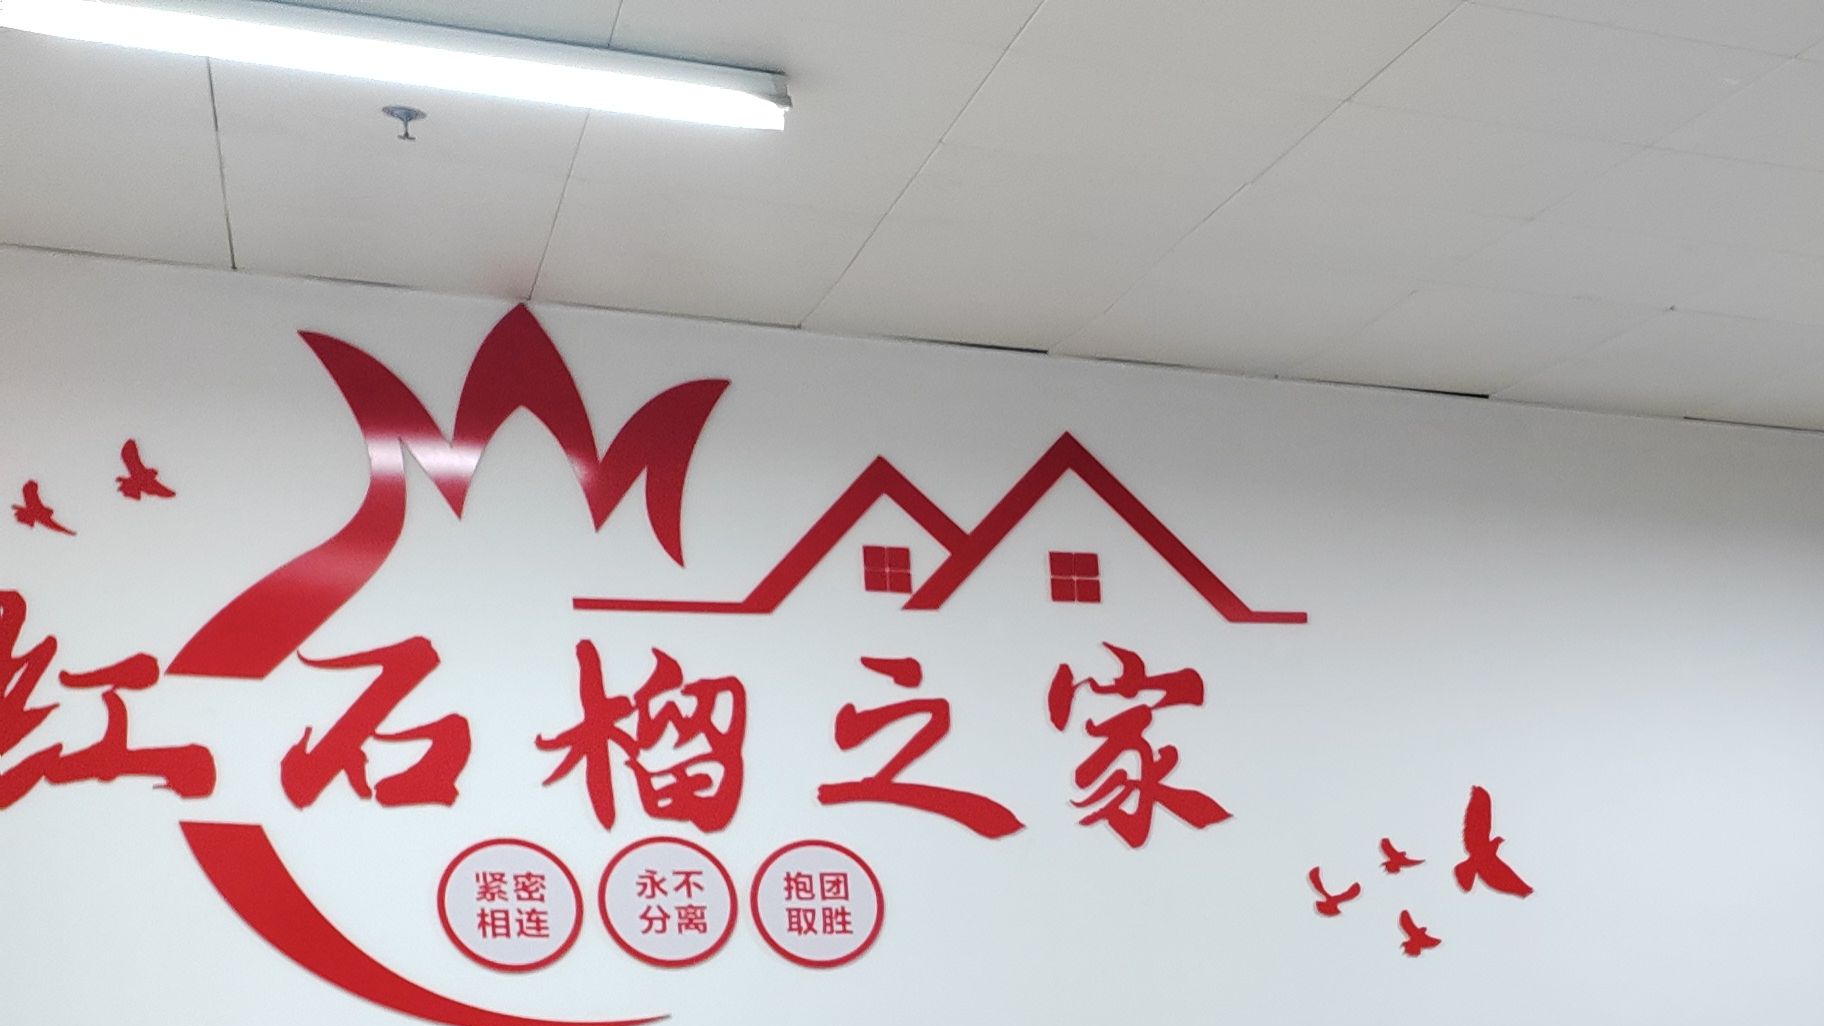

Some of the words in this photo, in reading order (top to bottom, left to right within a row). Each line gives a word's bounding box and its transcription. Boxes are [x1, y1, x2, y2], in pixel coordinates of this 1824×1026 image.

[0, 590, 1233, 849] 红石榴之家
[474, 871, 547, 903] 紧密
[636, 868, 705, 900] 永不
[783, 870, 850, 902] 抱团
[477, 907, 550, 939] 相连
[640, 903, 709, 935] 分离
[786, 905, 854, 936] 取胜
